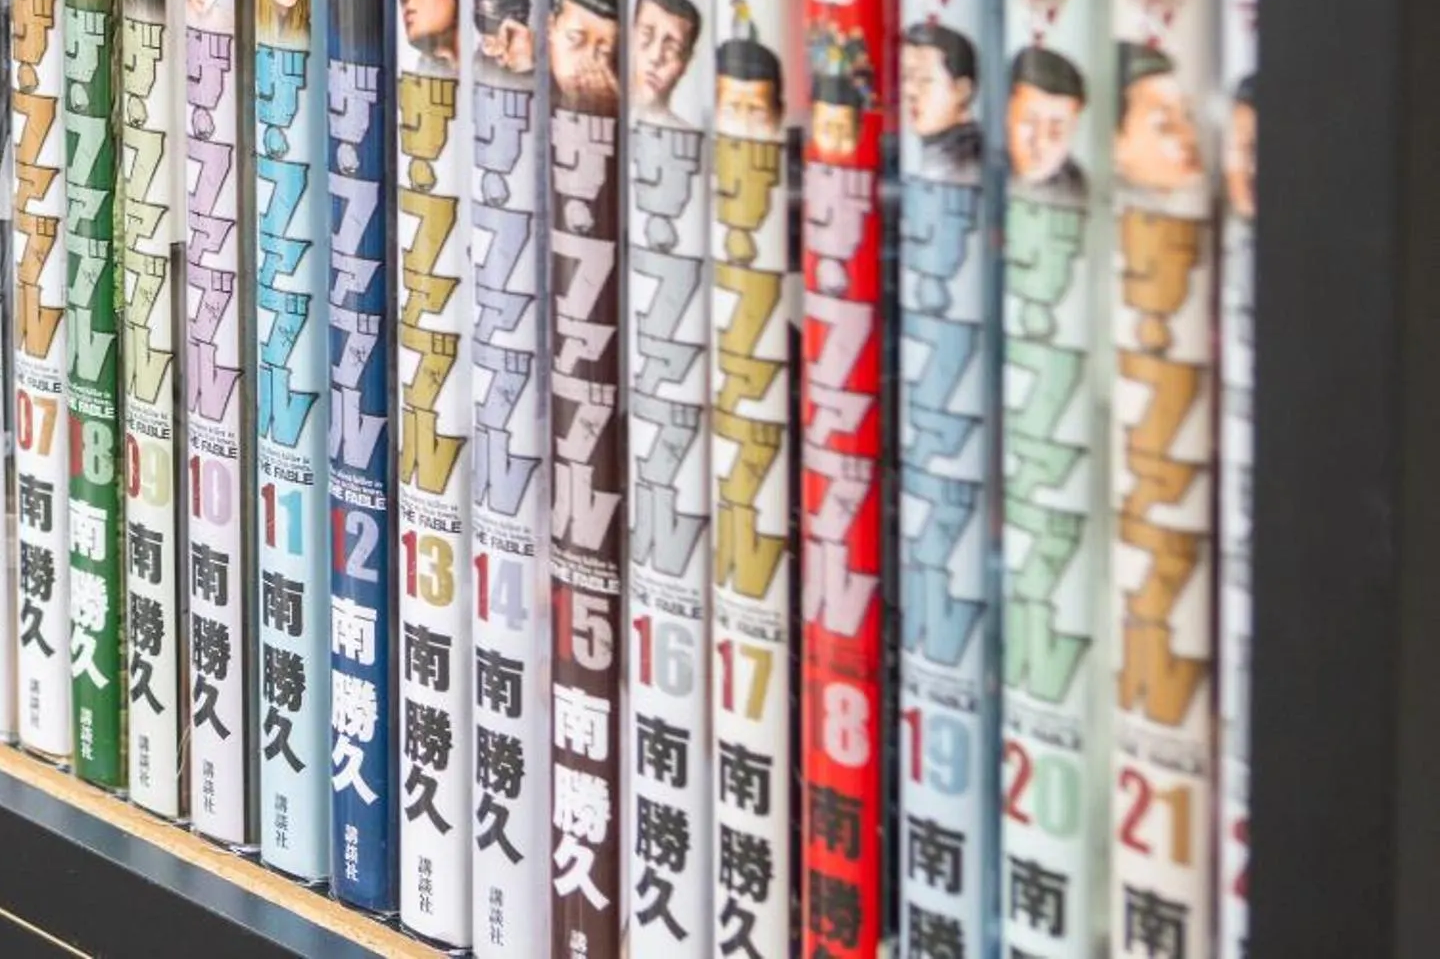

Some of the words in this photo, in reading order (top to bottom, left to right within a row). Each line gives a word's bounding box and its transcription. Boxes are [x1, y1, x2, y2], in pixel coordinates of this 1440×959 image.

[255, 42, 319, 448] ザ・ファブル
[327, 59, 387, 470] ザ・ファブル
[399, 72, 467, 494] ザ・ファブル
[472, 82, 541, 515] ザ・ファブル
[550, 110, 622, 550] ザ・ファブル
[17, 389, 58, 456] 07
[126, 433, 172, 507] 09
[189, 455, 232, 526] 10
[19, 474, 57, 658] 南勝久
[70, 499, 110, 689] 南勝久
[260, 483, 304, 556] 11
[332, 506, 380, 584] 12
[401, 529, 455, 609] 13
[473, 552, 527, 633] 14
[129, 521, 165, 715] 南勝久
[192, 543, 231, 740] 南勝久
[262, 569, 305, 774] 南勝久
[332, 594, 379, 806] 南勝久
[553, 585, 615, 673] 15
[632, 614, 695, 698] 16
[716, 641, 774, 723] 17
[403, 620, 452, 835] 南勝久
[476, 645, 524, 865] 南勝久
[553, 682, 610, 911] 南勝久
[902, 707, 970, 797] 19
[1005, 740, 1080, 841] 20
[417, 855, 433, 916] 講談社
[636, 712, 691, 941] 南勝久
[719, 737, 774, 959] 南勝久
[809, 782, 864, 959] 南勝
[1119, 766, 1192, 869] 21
[488, 887, 504, 947] 講談社
[1124, 884, 1188, 959] 南
